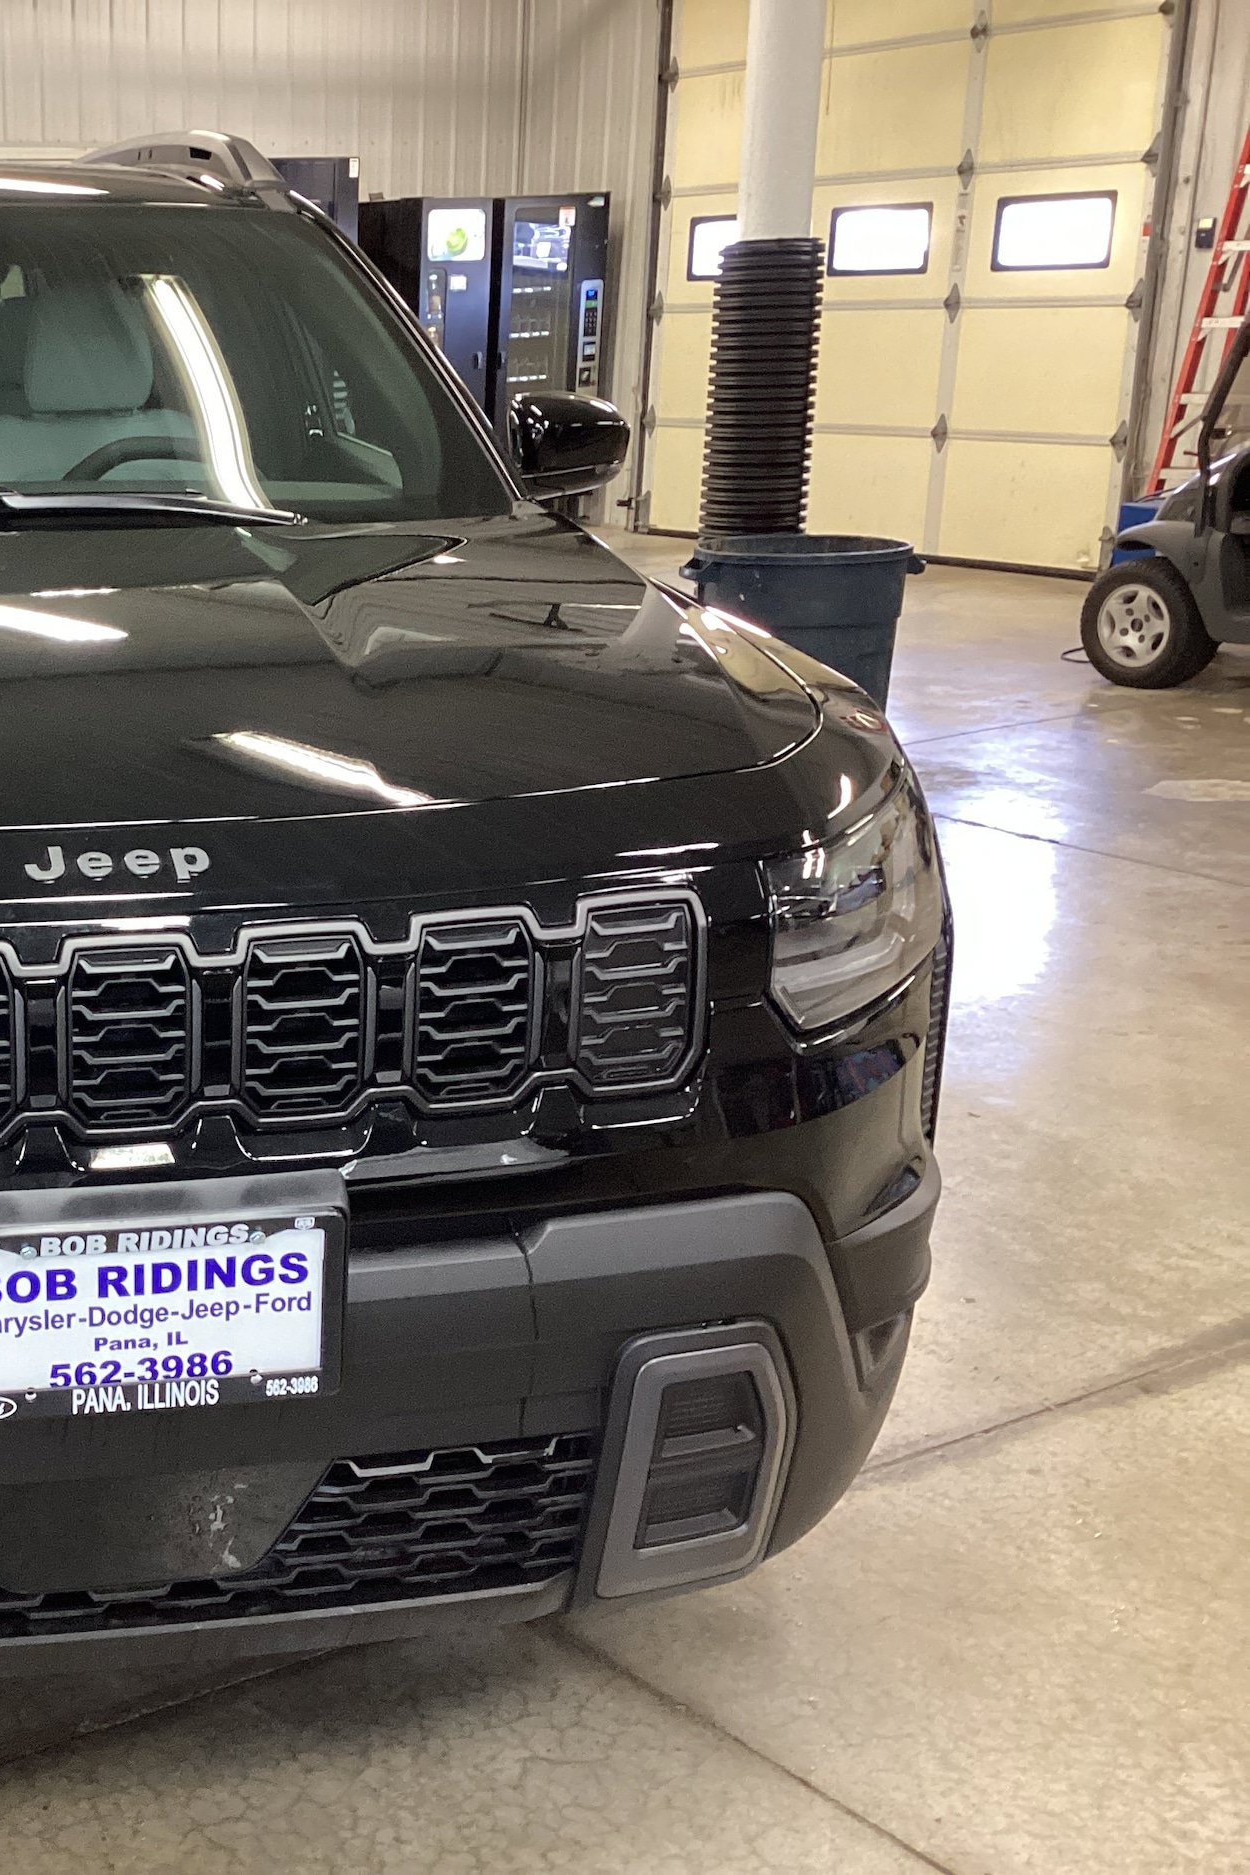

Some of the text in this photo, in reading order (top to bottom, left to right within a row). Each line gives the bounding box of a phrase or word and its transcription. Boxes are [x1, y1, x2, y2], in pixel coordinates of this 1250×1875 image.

[24, 845, 211, 884] Jeep
[39, 1223, 250, 1258] BOB RIDINGS
[97, 1252, 310, 1299] RIDINGS
[93, 1331, 189, 1352] Pana, IL
[50, 1350, 234, 1388] 562-3986
[265, 1375, 319, 1397] 562-3986
[72, 1379, 220, 1415] PANA, ILLINOIS
